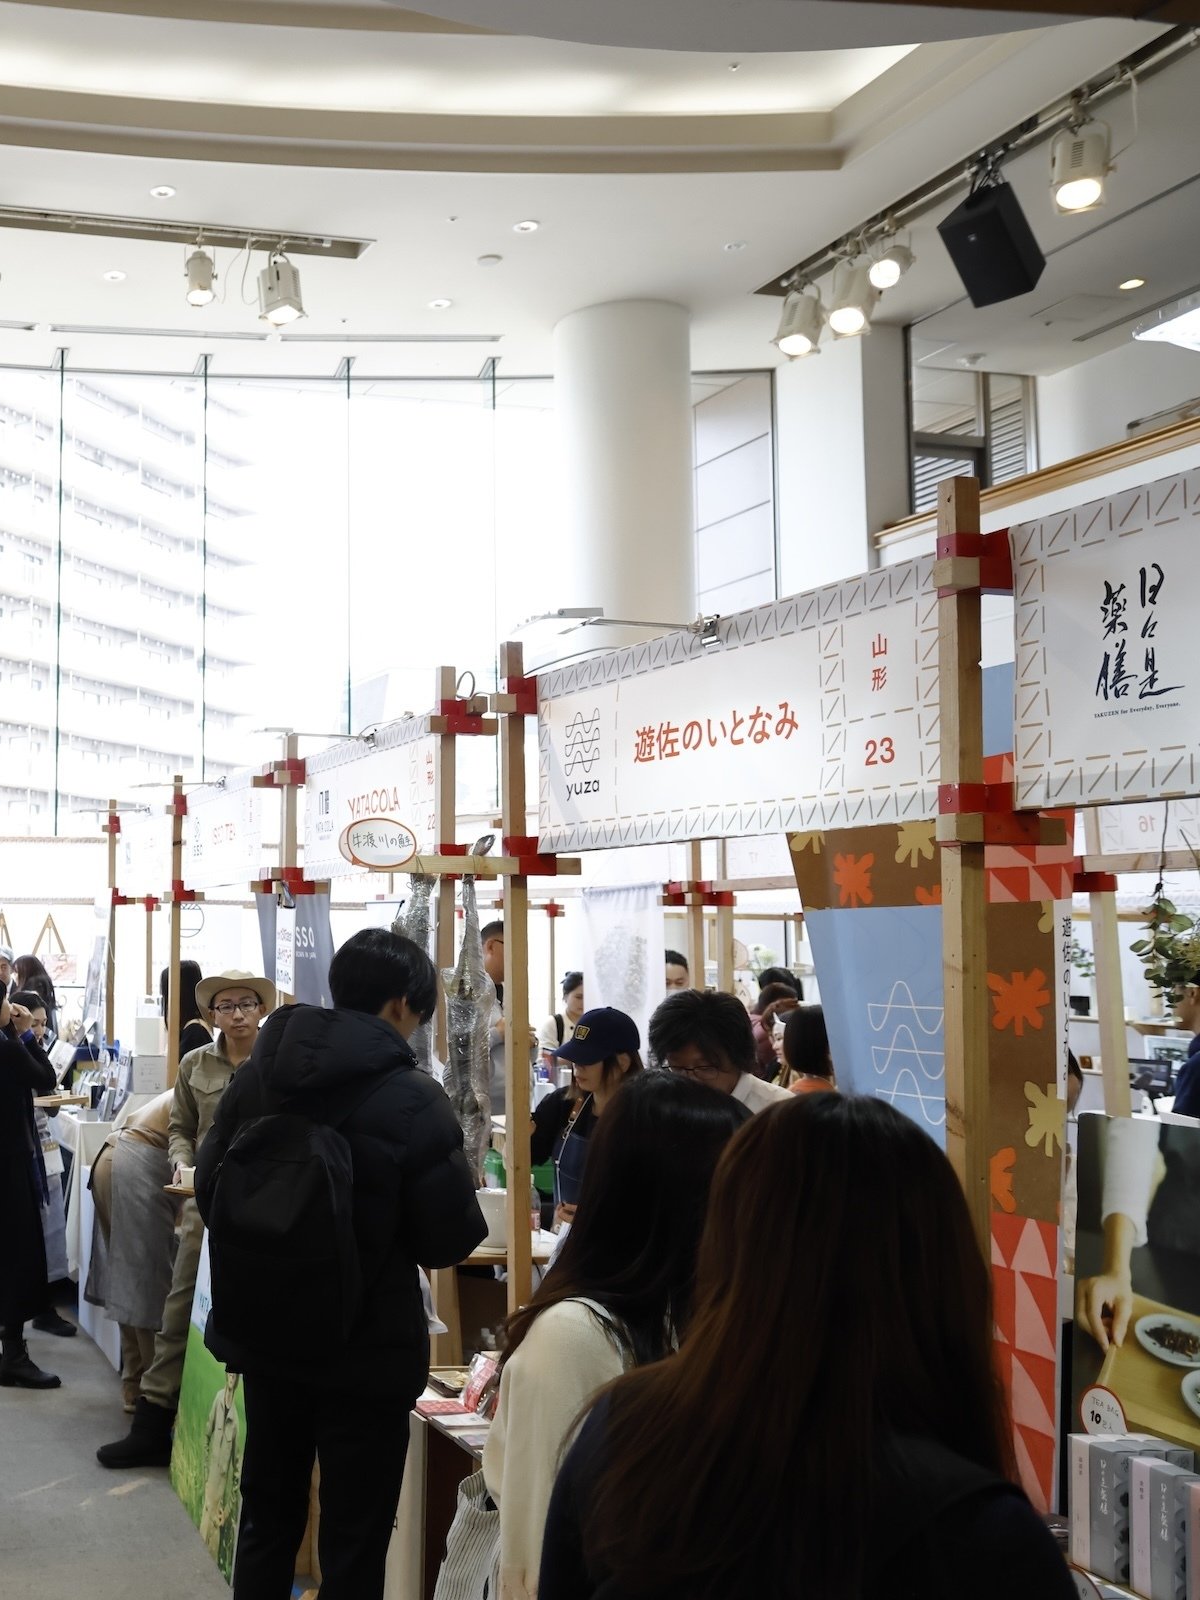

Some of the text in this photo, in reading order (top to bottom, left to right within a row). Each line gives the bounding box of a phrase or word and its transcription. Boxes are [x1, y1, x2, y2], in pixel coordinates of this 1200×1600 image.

[871, 634, 887, 692] 山形
[634, 702, 798, 763] 遊佐のいとなみ
[865, 738, 895, 766] 23
[347, 787, 400, 820] YATACOLA
[566, 779, 599, 800] yuza
